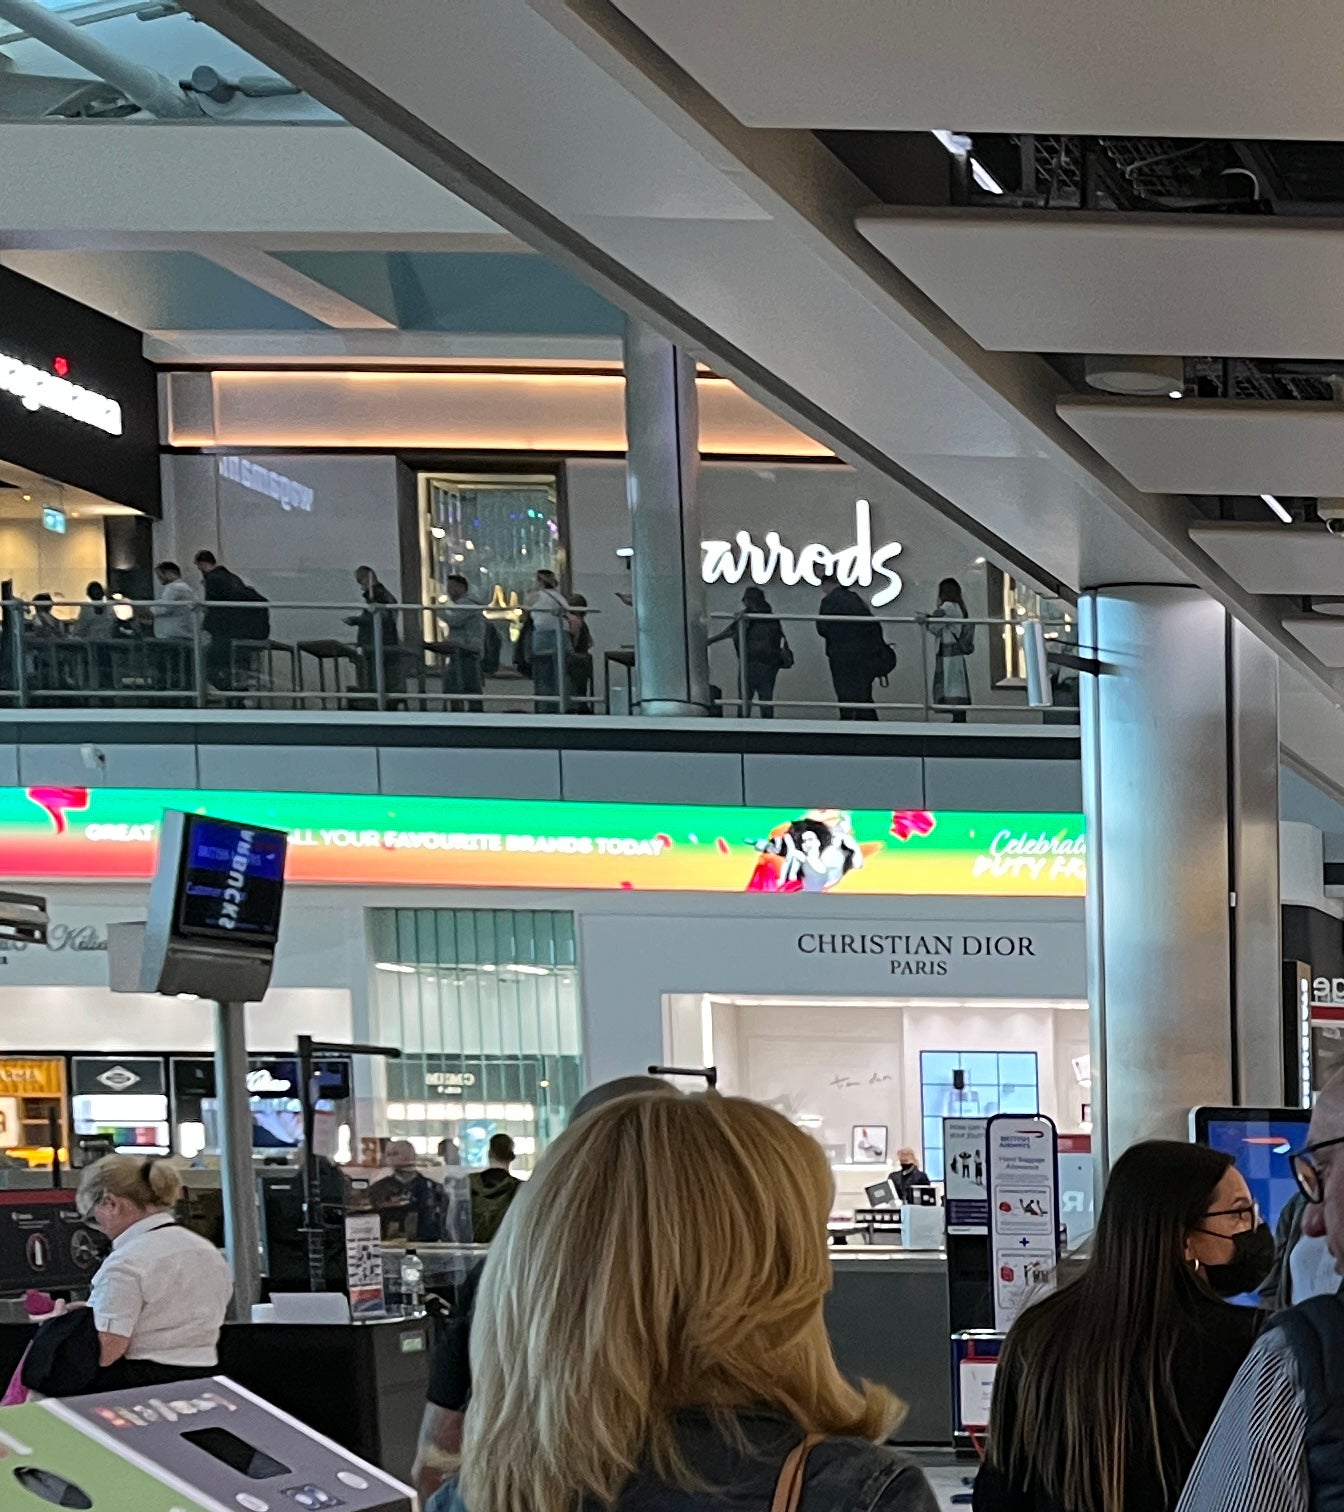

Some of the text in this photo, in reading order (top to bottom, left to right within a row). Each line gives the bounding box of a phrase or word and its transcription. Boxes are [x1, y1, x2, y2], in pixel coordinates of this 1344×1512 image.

[700, 499, 903, 608] arrods
[320, 830, 381, 848] YOUR
[384, 831, 503, 853] FAVOURITE
[505, 834, 595, 856] BRANDS
[595, 836, 665, 858] TODAY
[797, 933, 1037, 958] CHRISTIAN DIOR
[889, 960, 949, 977] PARIS
